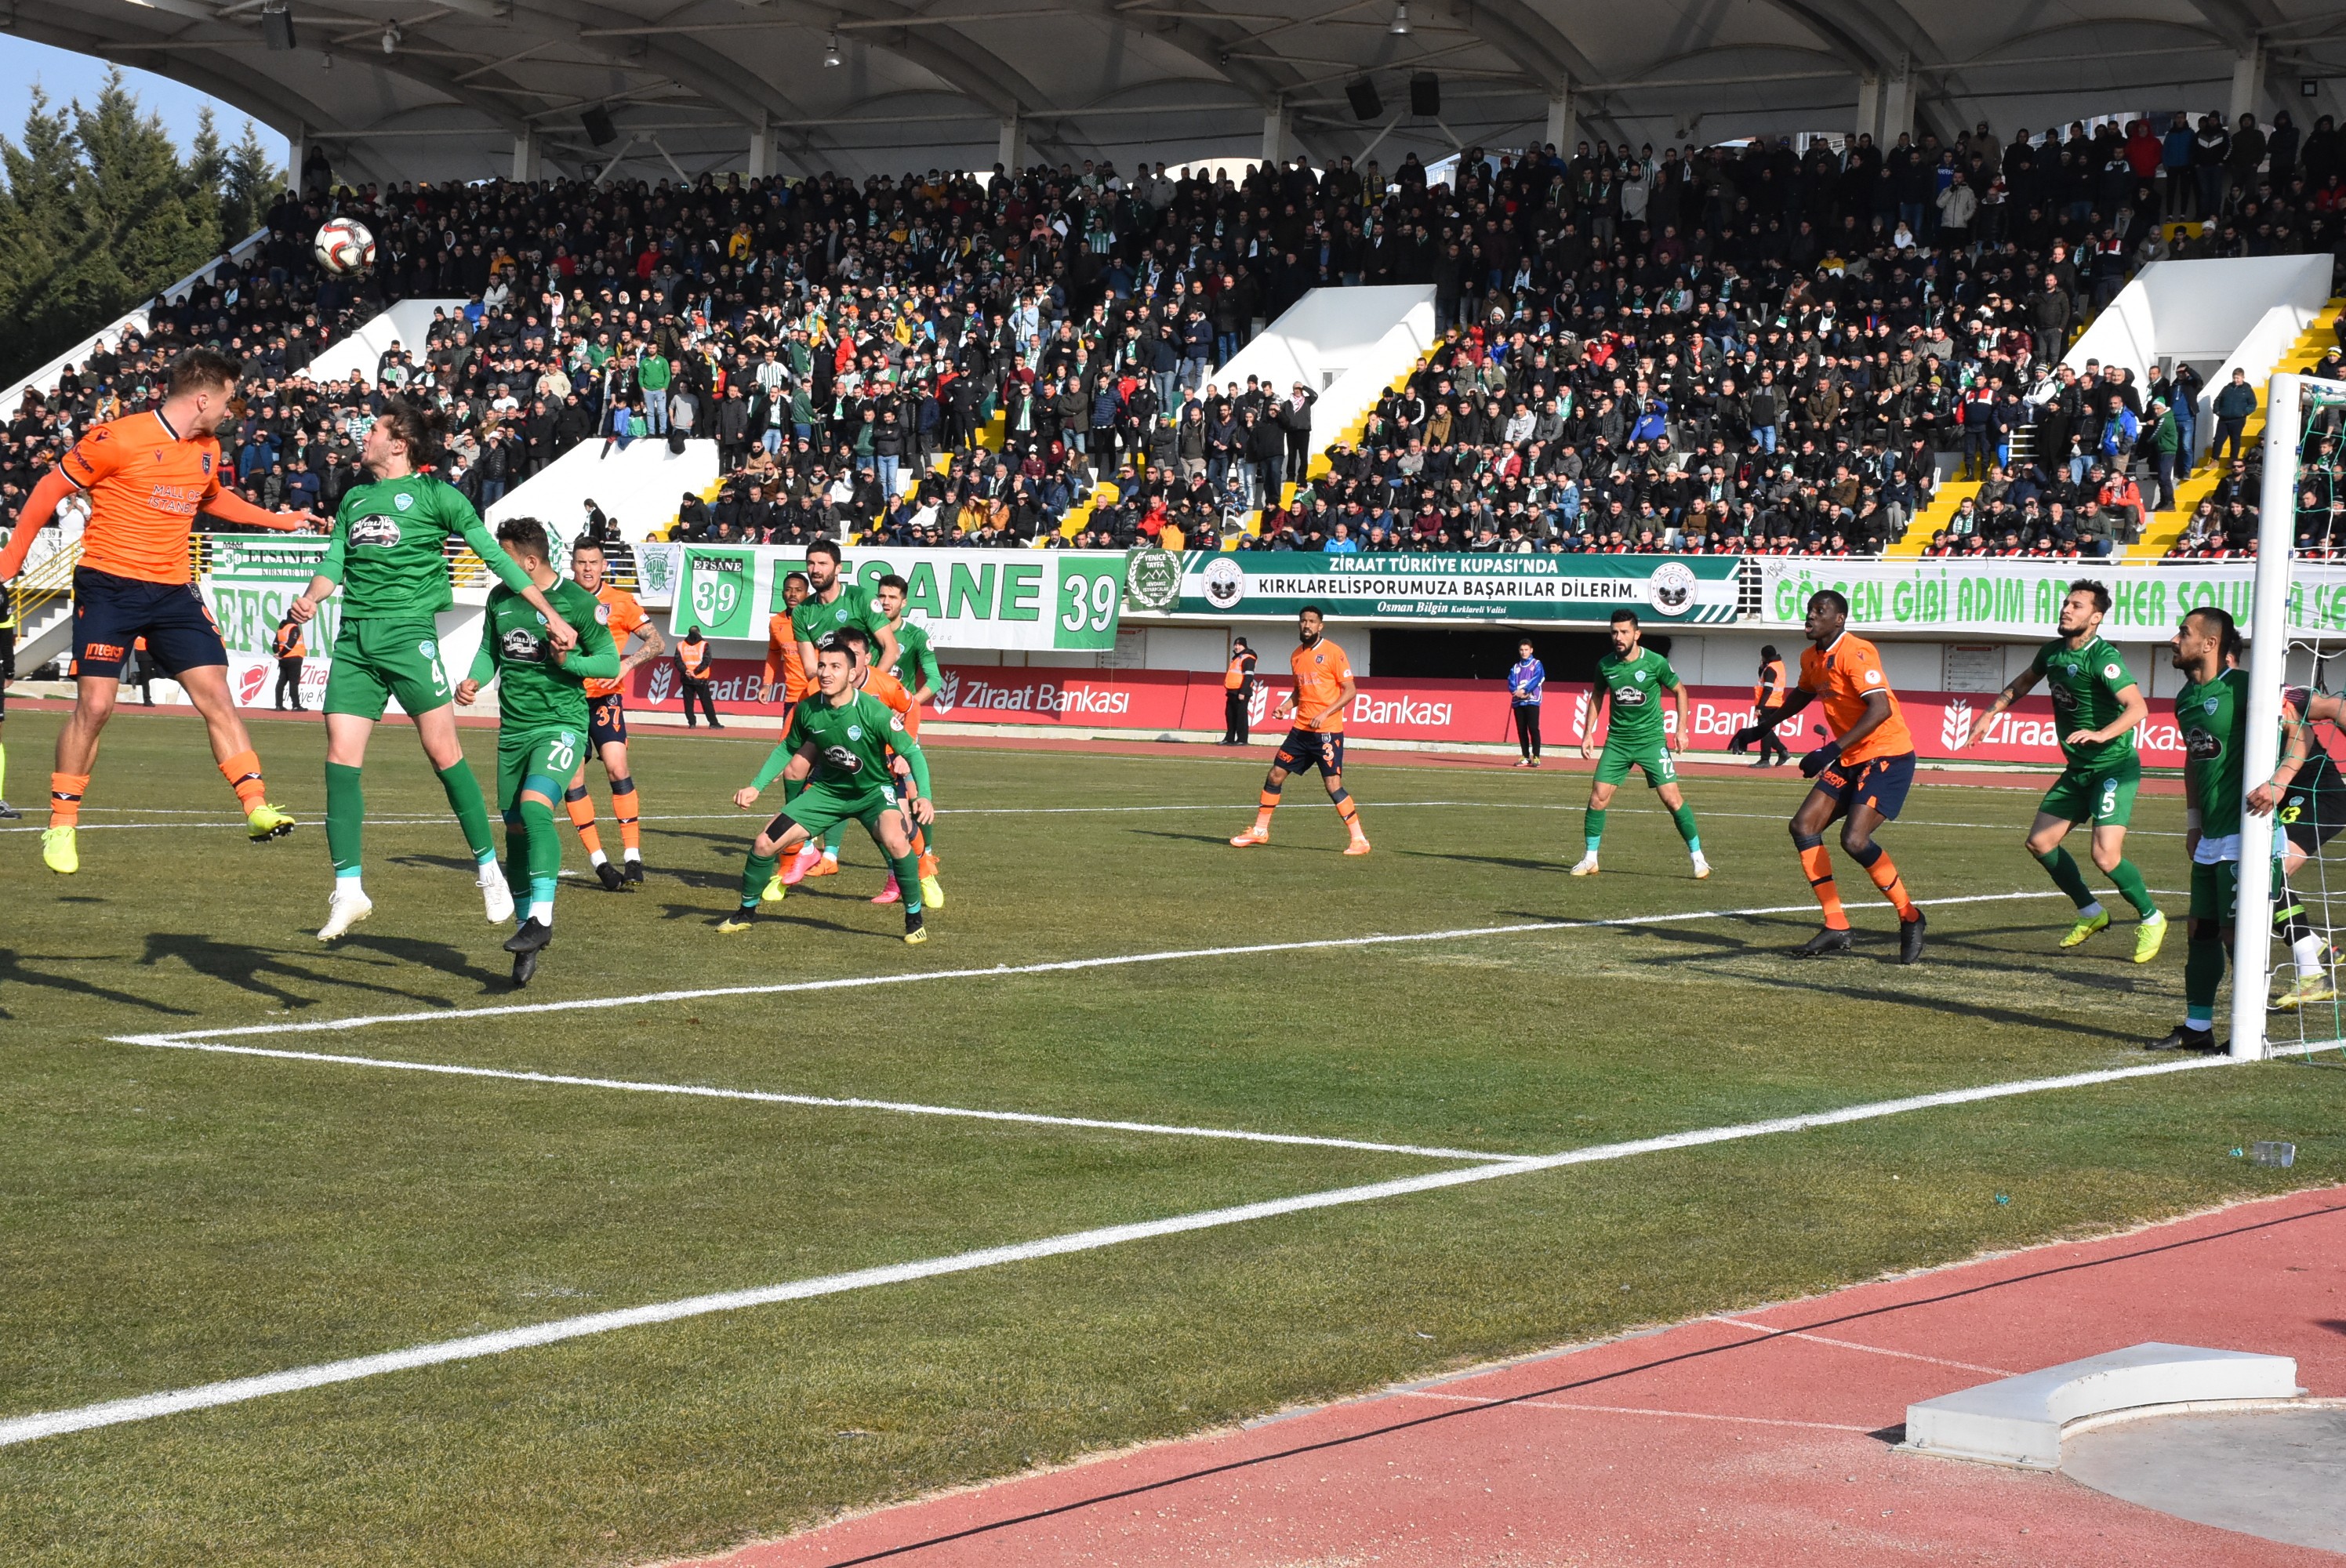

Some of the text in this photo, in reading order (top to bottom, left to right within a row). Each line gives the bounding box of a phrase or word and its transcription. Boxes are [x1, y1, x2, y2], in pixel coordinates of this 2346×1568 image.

[152, 484, 183, 499] MALL
[147, 495, 196, 514] ISTANBU
[226, 553, 242, 565] 39
[248, 550, 323, 564] EFSANE 3
[693, 560, 742, 572] EFSANE
[1145, 553, 1166, 561] YENİCE
[1329, 555, 1558, 574] ZİRAAT TÜRKİYE KUPASI'NDA
[695, 582, 735, 612] 39
[769, 559, 1044, 622] ESANE
[1258, 576, 1638, 600] KIRKLARELİSPORUMUZA BAŞARILAR DİLERİM.
[1893, 568, 1947, 622] GİBİ
[1956, 577, 2024, 623] ADIM
[2114, 580, 2166, 626] HER
[1061, 573, 1118, 633] 39
[1377, 601, 1507, 615] Osman Bilgin Kırklareli Valisi
[432, 659, 445, 686] 4
[962, 681, 1130, 713] Ziraat Bankası
[596, 706, 620, 727] 37
[1353, 693, 1452, 725] Bankası
[1981, 712, 2058, 746] Ziraa
[547, 740, 573, 770] 70
[1322, 743, 1335, 760] 3
[2101, 792, 2115, 812] 5
